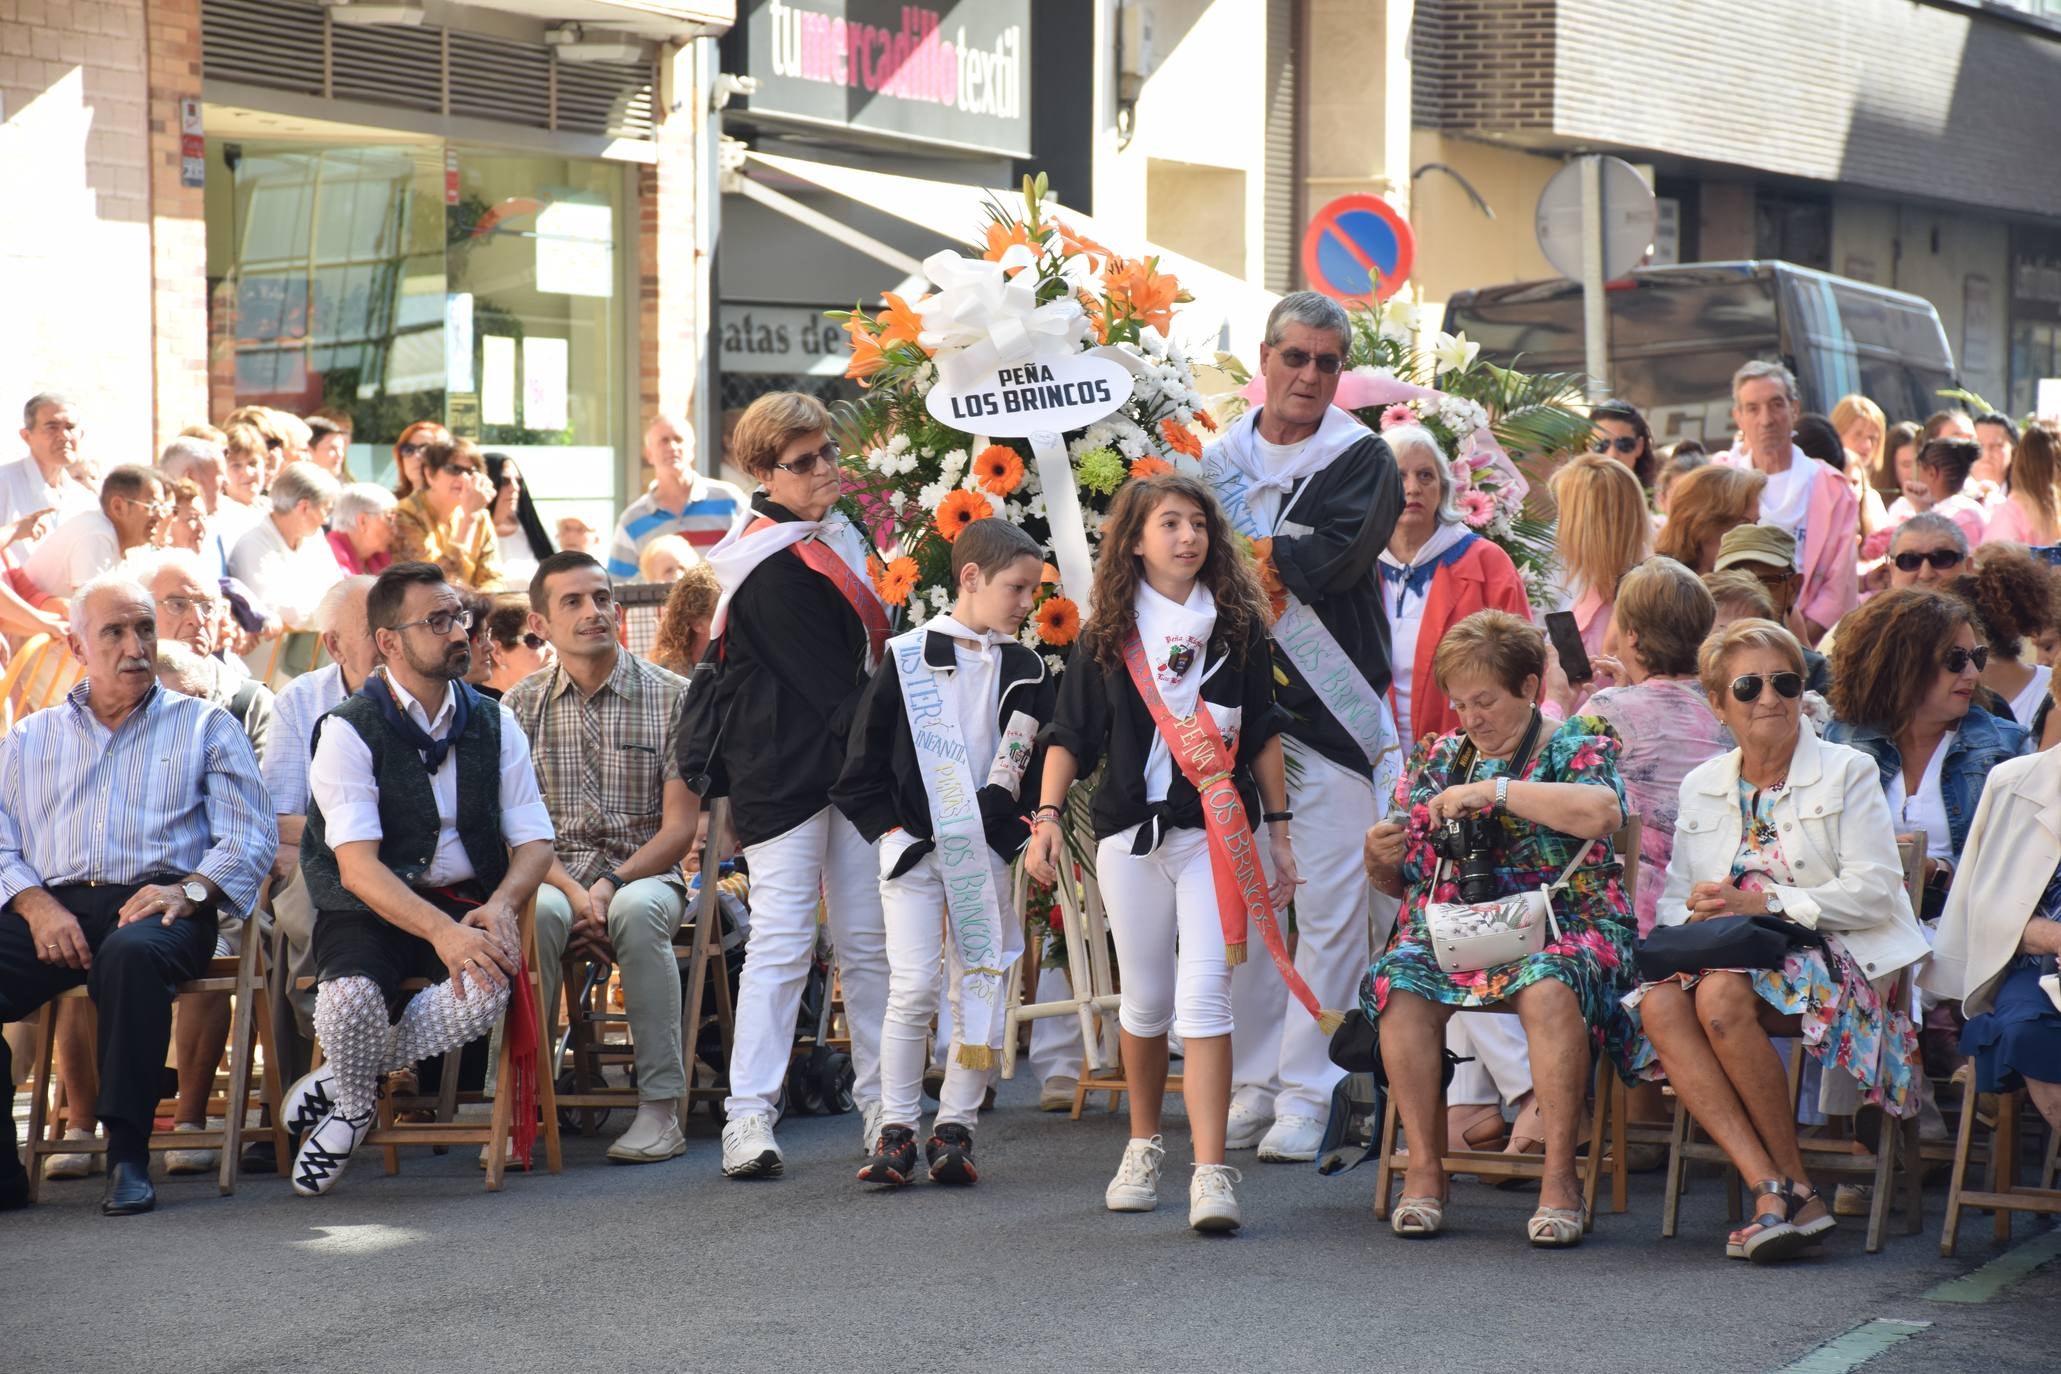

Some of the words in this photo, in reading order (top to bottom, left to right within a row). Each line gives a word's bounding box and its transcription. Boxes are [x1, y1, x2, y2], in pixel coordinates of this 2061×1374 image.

[719, 312, 791, 354] atas
[801, 313, 839, 354] de
[998, 362, 1054, 387] PEÑA
[951, 392, 999, 419] LOS
[1003, 379, 1111, 413] BRINCOS
[1173, 713, 1216, 771] PEÑA
[1224, 826, 1272, 936] BRINCOS
